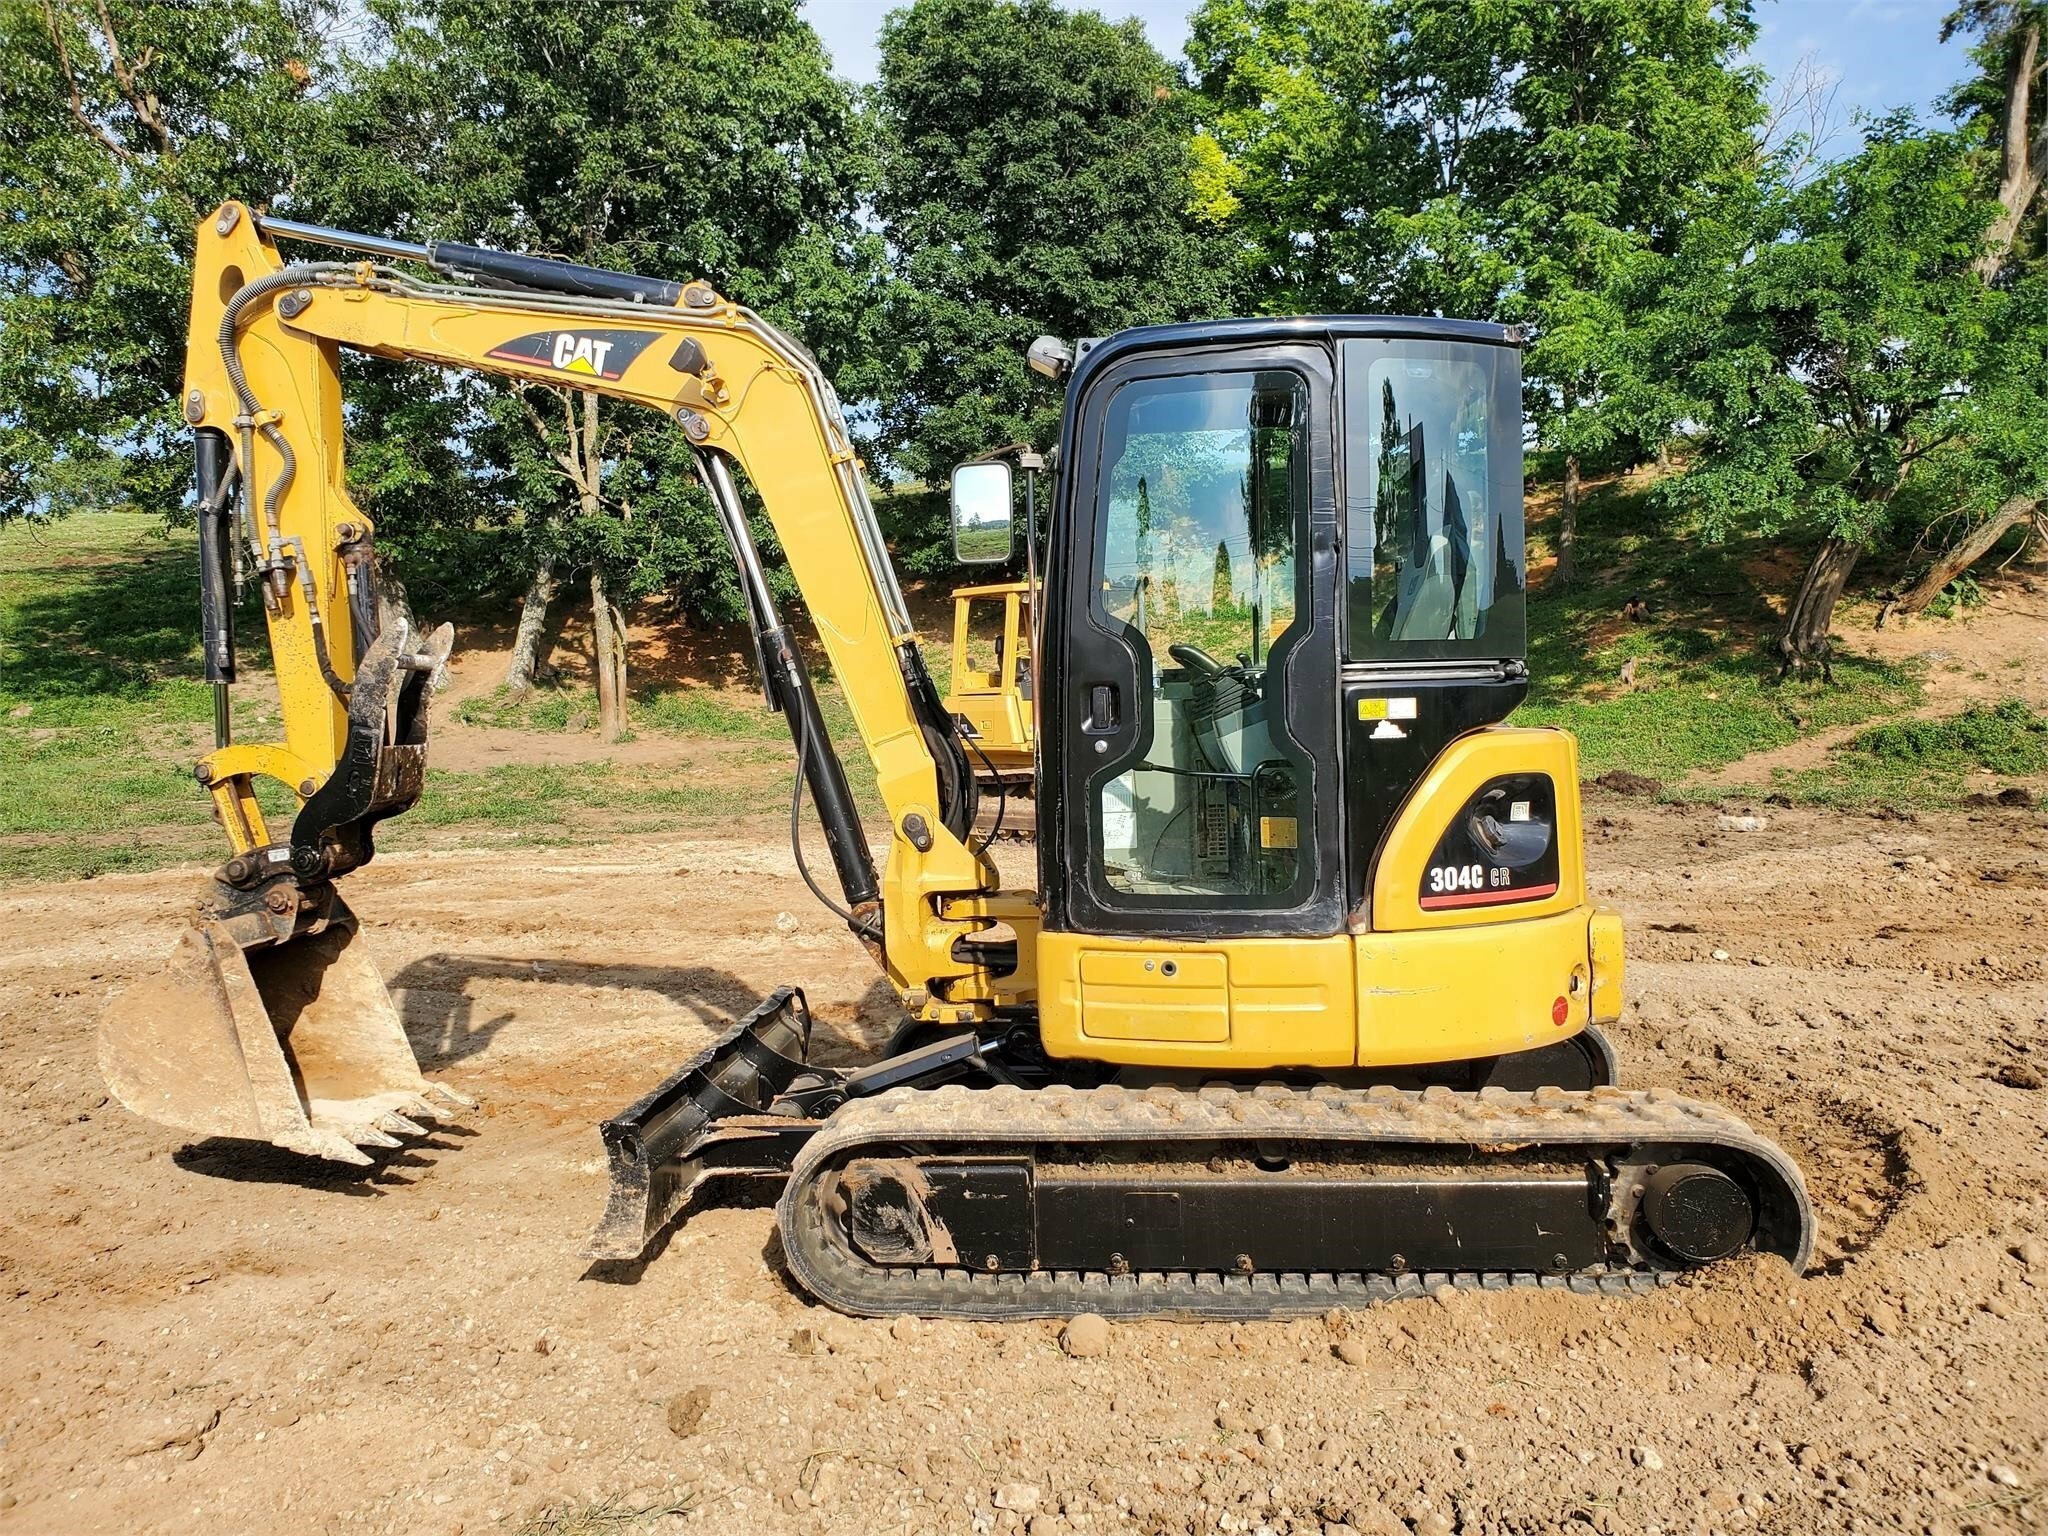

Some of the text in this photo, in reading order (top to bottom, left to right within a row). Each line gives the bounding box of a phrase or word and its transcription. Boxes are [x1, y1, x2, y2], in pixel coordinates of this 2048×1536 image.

[553, 333, 614, 377] CAT
[1430, 864, 1511, 892] 304C CR
